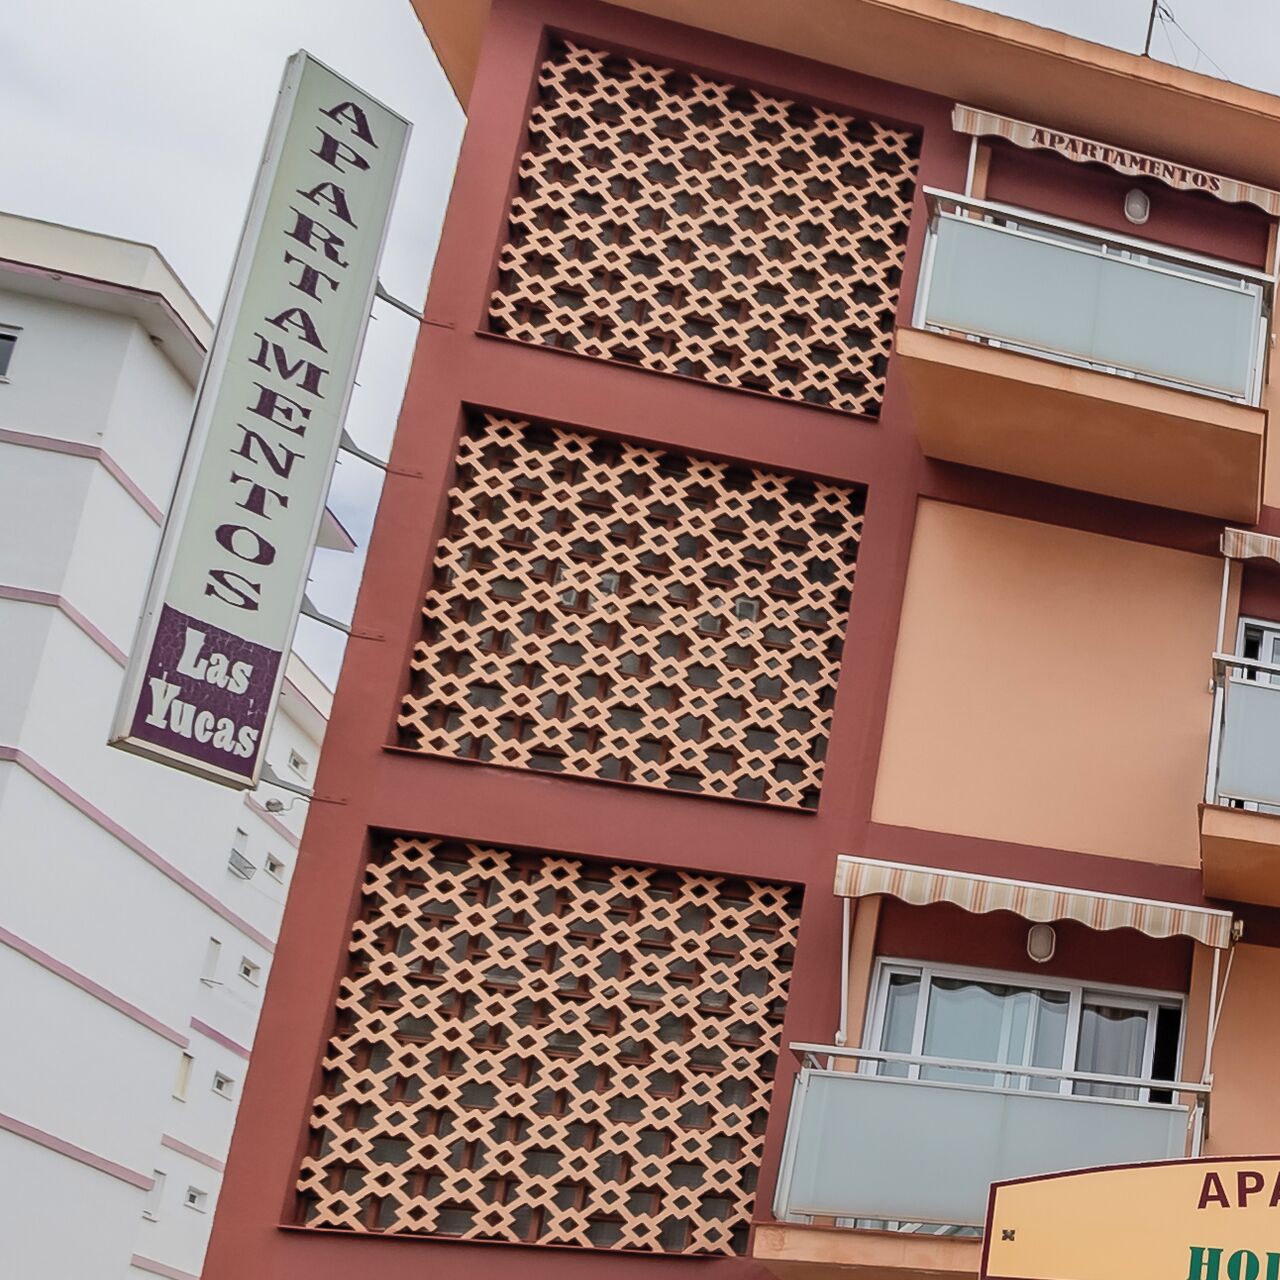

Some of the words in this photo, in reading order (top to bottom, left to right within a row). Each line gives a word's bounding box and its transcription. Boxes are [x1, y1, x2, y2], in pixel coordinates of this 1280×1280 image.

[1031, 128, 1223, 192] APARTAMENTOS
[204, 101, 379, 612] APARTAMENTOS
[175, 629, 254, 695] Las
[144, 679, 259, 757] Yucas
